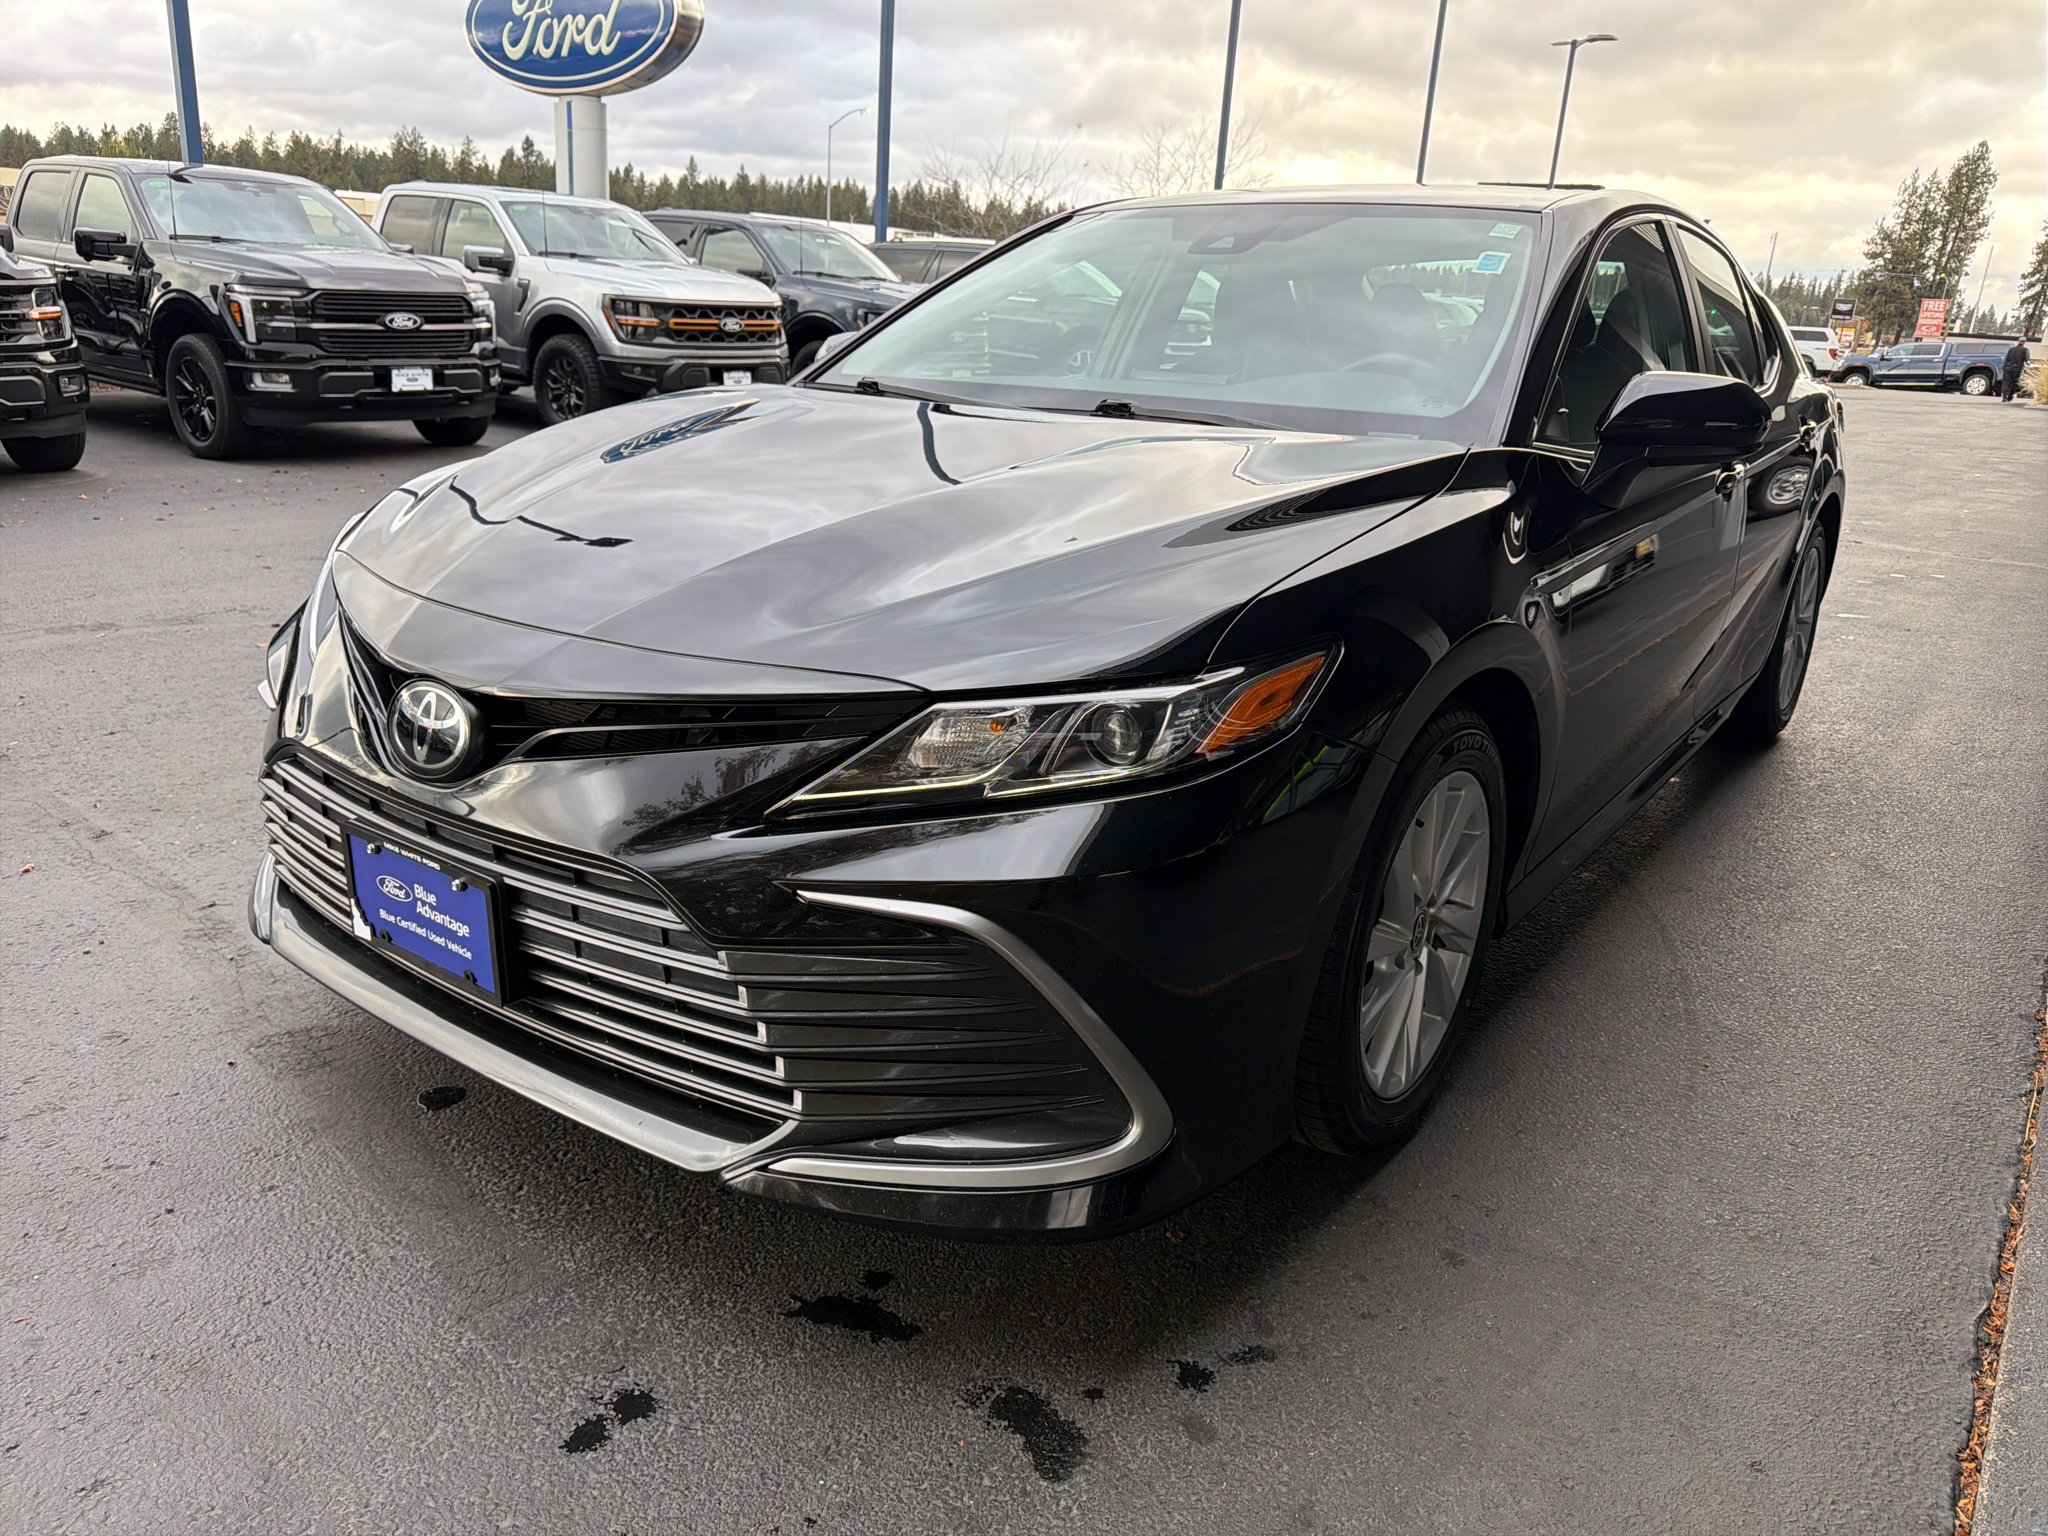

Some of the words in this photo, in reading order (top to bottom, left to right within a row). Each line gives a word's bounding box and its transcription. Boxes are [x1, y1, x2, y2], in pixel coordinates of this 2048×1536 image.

[502, 0, 621, 61] Ford
[1923, 300, 1946, 311] FREE
[1452, 734, 1481, 755] TOYO
[400, 848, 422, 863] WHITE
[422, 857, 441, 871] FORD
[383, 878, 406, 899] Ford
[414, 883, 437, 906] Blue
[416, 900, 470, 938] Advantage
[379, 908, 396, 924] Blue
[396, 916, 427, 938] Certified
[427, 929, 446, 947] Used
[446, 938, 473, 960] Vehicle
